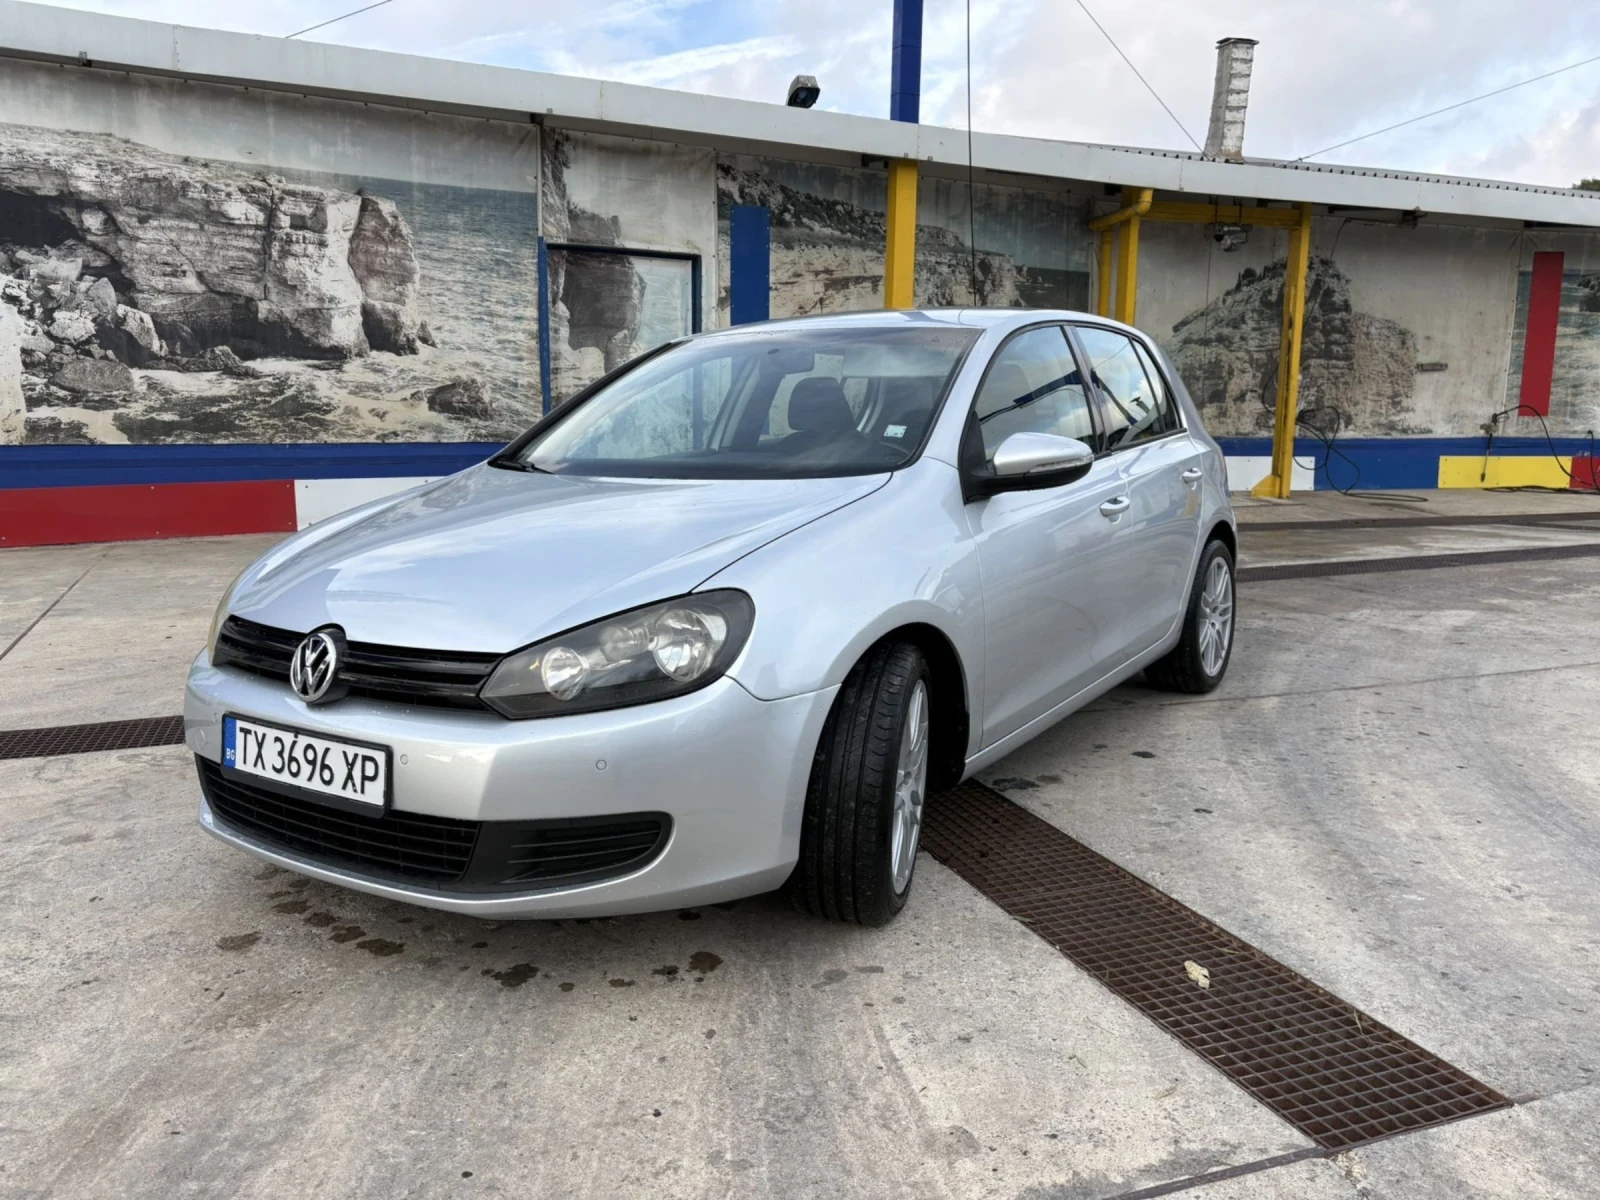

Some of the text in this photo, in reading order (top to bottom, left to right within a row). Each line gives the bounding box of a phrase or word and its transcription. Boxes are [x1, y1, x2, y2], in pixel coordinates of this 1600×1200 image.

[291, 633, 337, 702] VW
[226, 748, 235, 760] BG
[239, 727, 379, 795] TX 3696 XP
